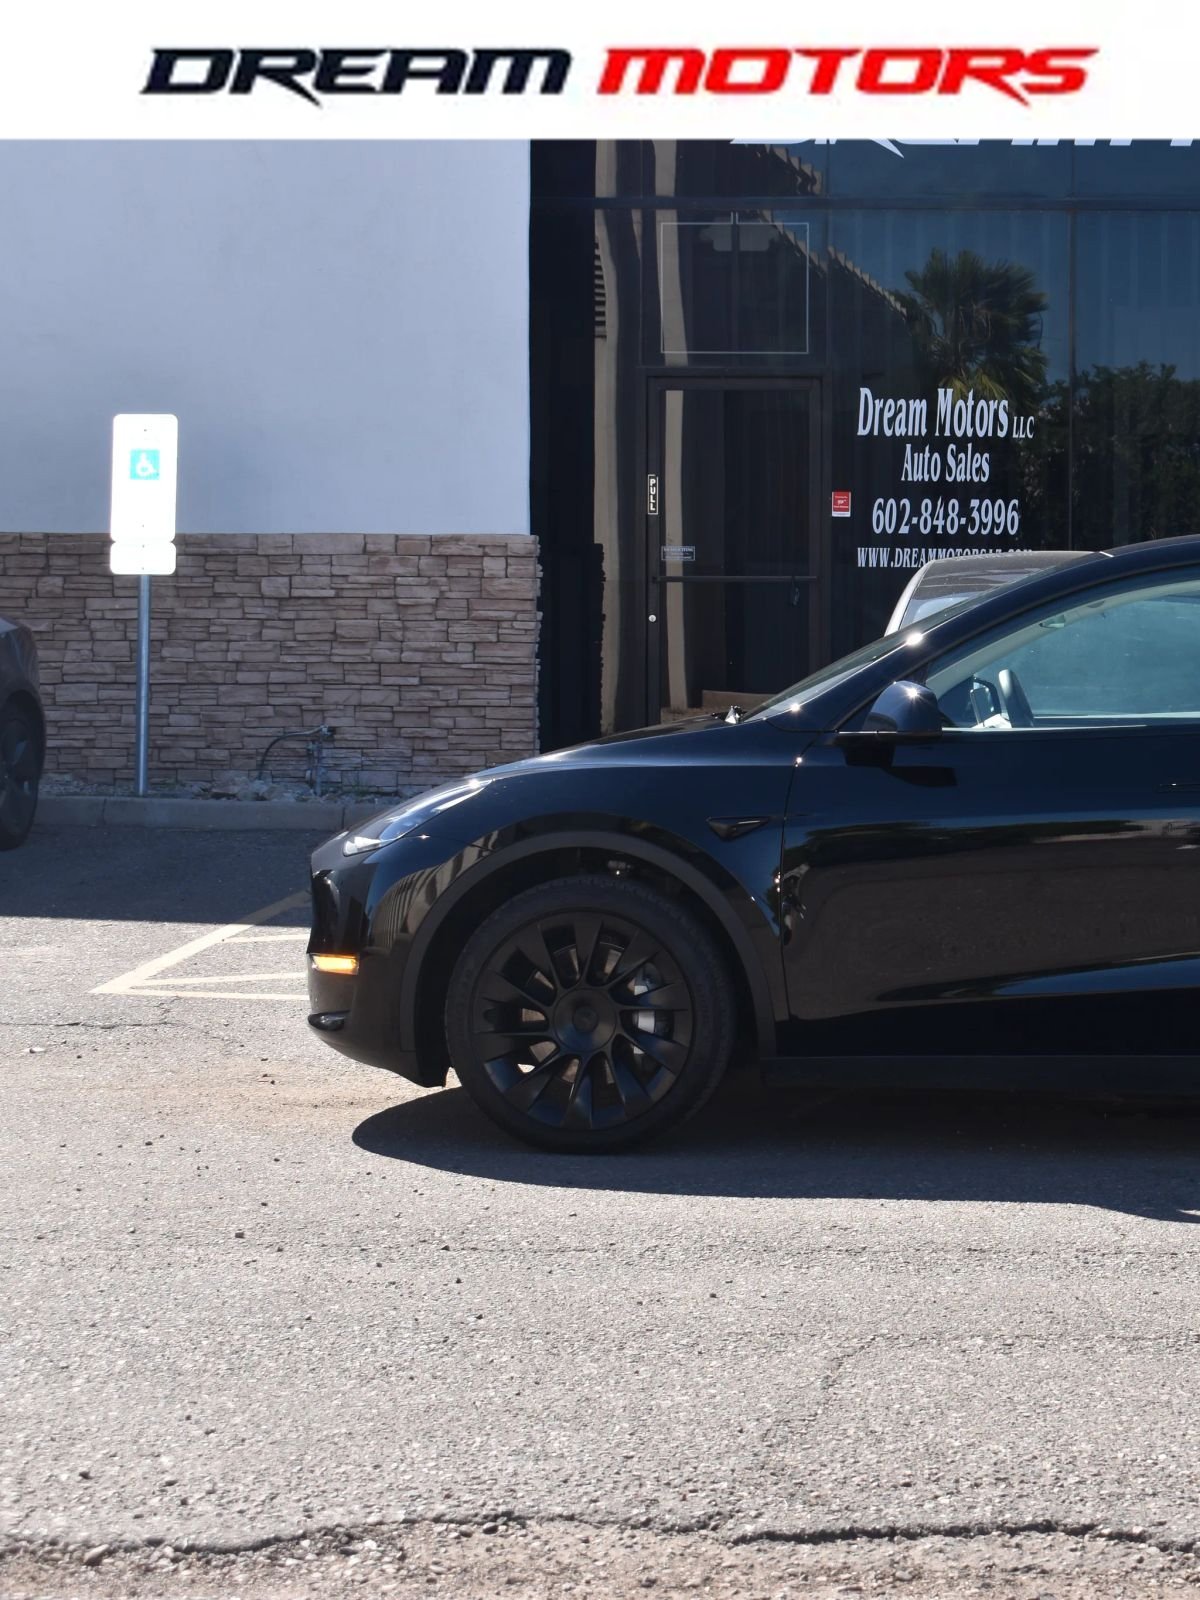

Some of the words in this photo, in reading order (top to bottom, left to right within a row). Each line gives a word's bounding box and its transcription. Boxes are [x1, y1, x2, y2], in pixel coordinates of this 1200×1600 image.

[857, 387, 927, 437] Dream
[935, 387, 1009, 437] Motors
[1012, 415, 1035, 438] LLC
[901, 443, 941, 482] Auto
[945, 442, 990, 482] Sales
[872, 496, 1019, 536] 602-848-3996
